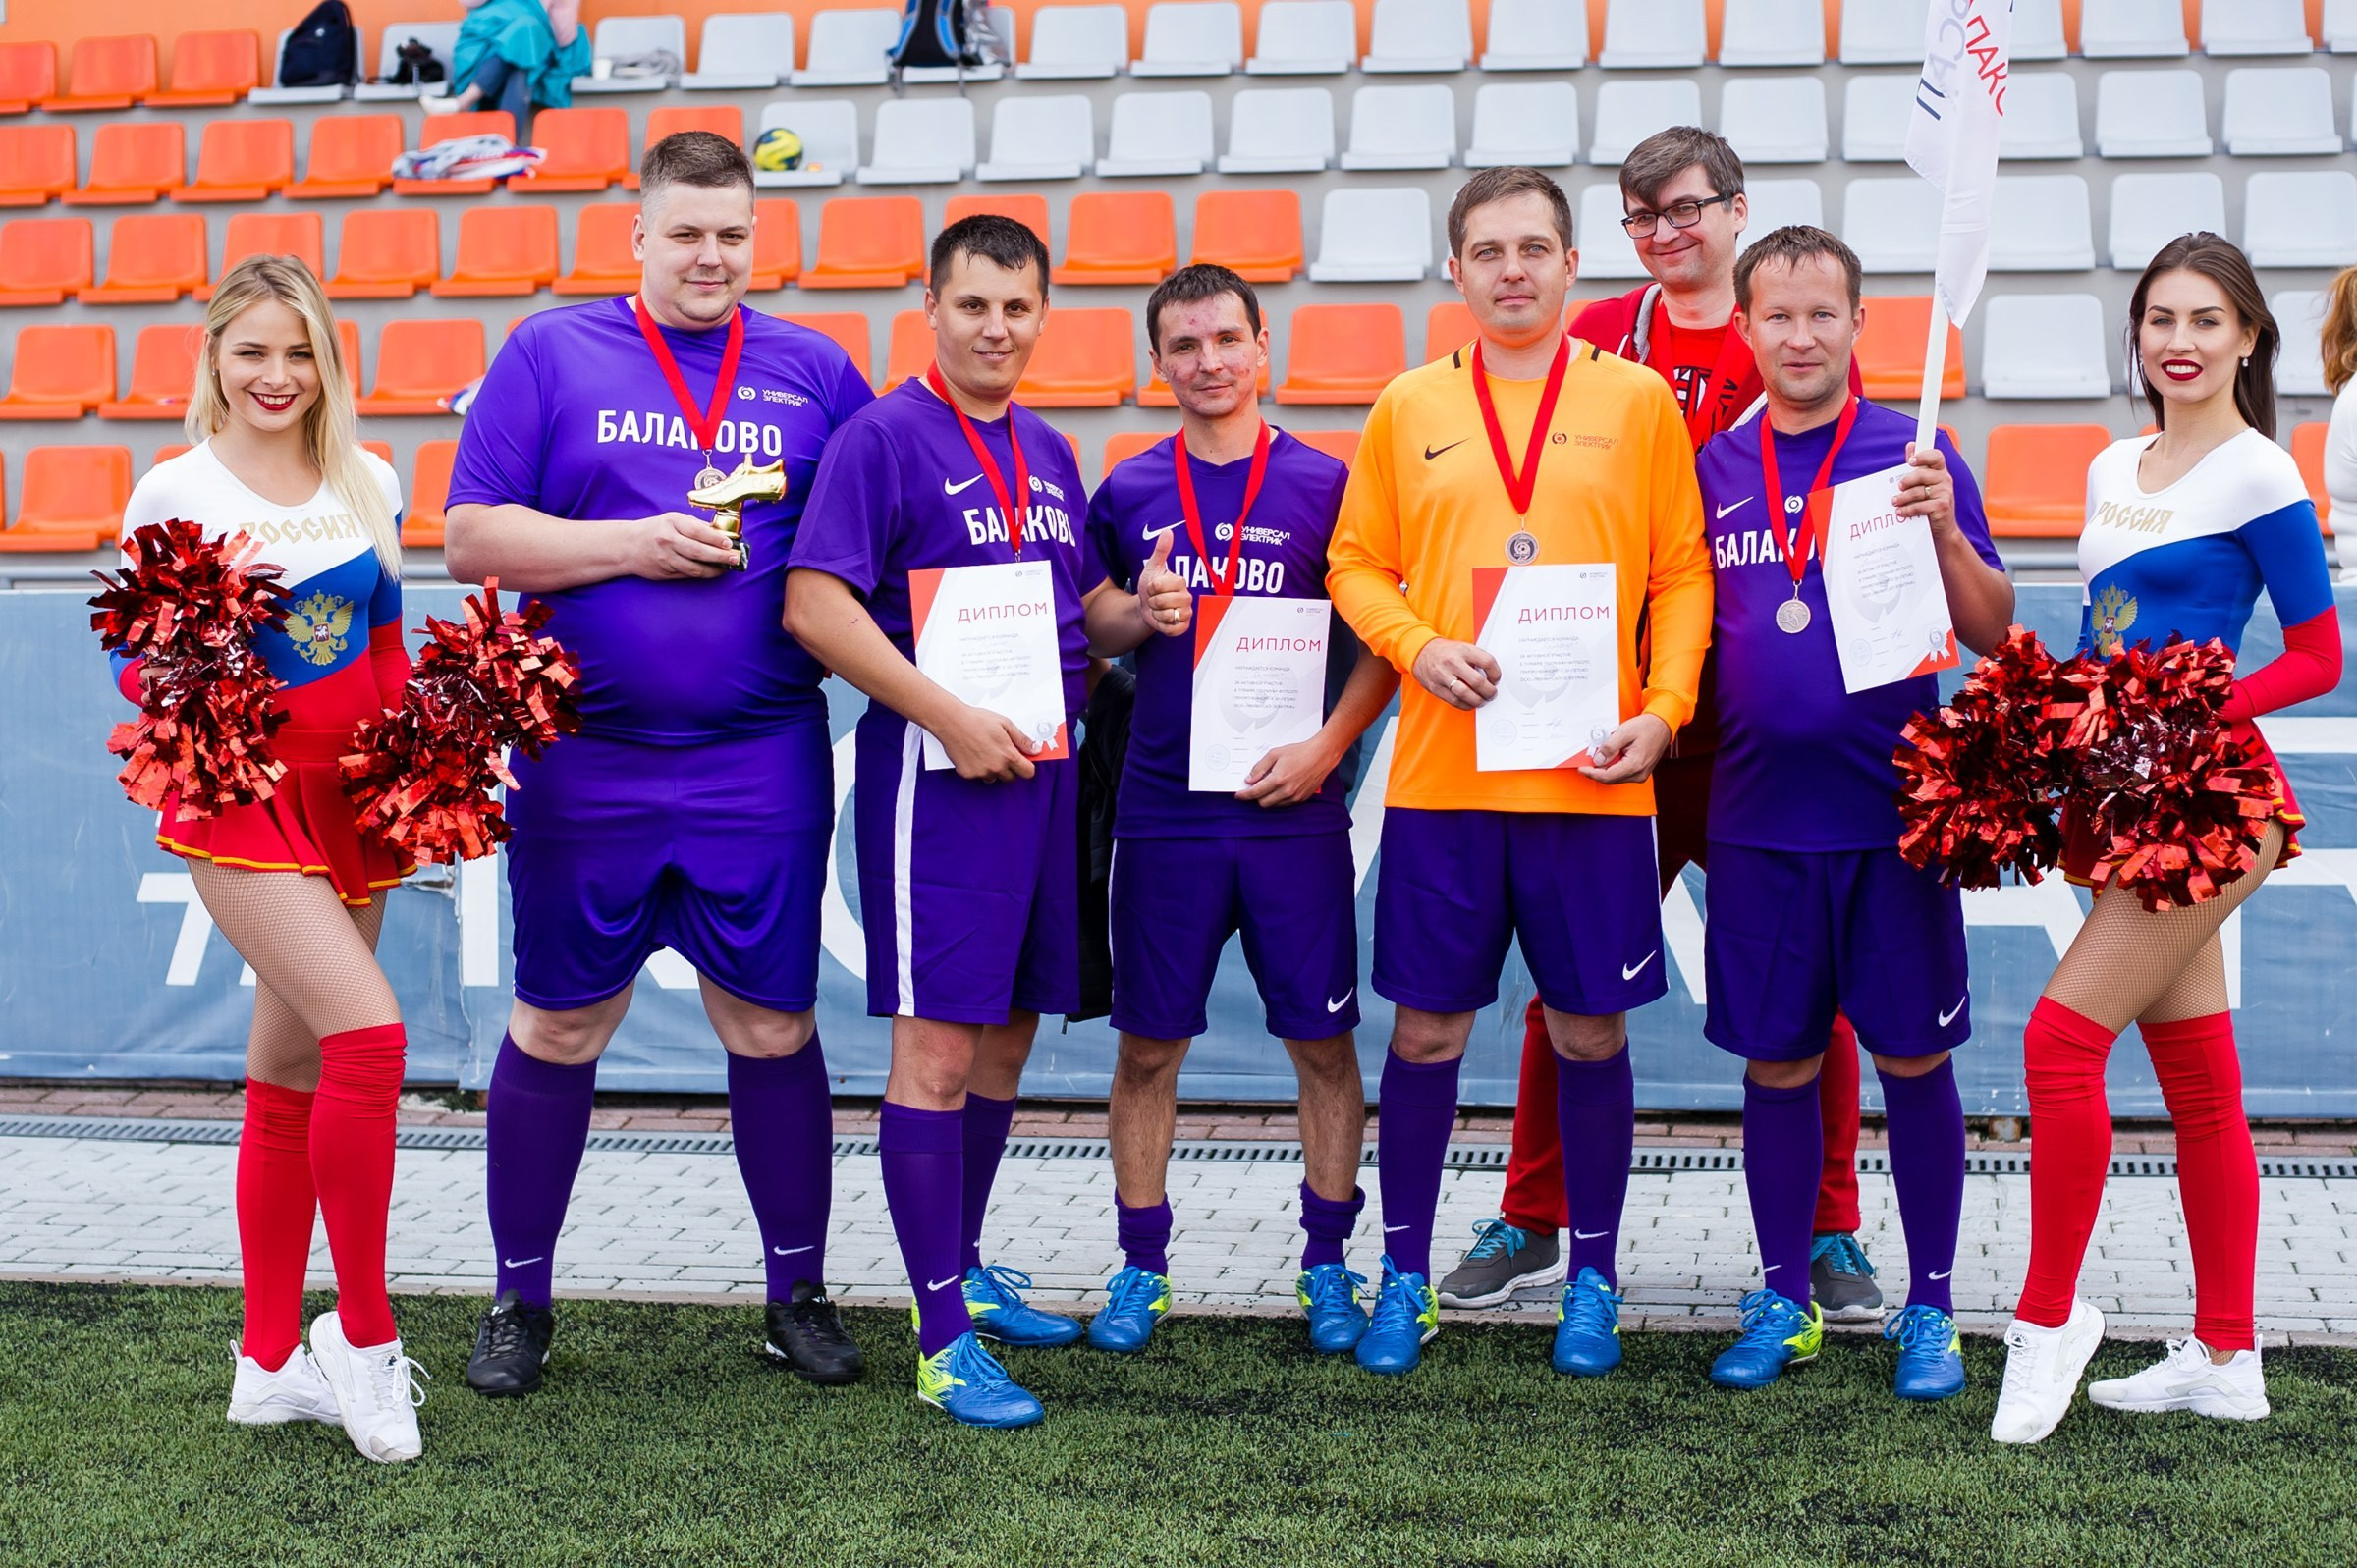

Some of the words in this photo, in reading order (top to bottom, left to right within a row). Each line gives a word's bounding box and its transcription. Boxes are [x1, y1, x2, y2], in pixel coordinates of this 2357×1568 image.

[761, 389, 808, 404] УНИВЕРСАЛ
[597, 409, 783, 457] БАЛАОВО
[1850, 513, 1922, 542] ДИПЛО
[2089, 501, 2174, 534] РОССИЯ
[1240, 525, 1291, 540] УНИВЕРСАЛ
[1240, 533, 1283, 546] ЭЛЕКТРИК
[1143, 555, 1285, 594] ЛАКОВО
[958, 602, 1048, 624] ДИПЛОМ
[1517, 606, 1610, 624] ДИПЛОМ
[1236, 637, 1322, 653] ДИПЛОМ
